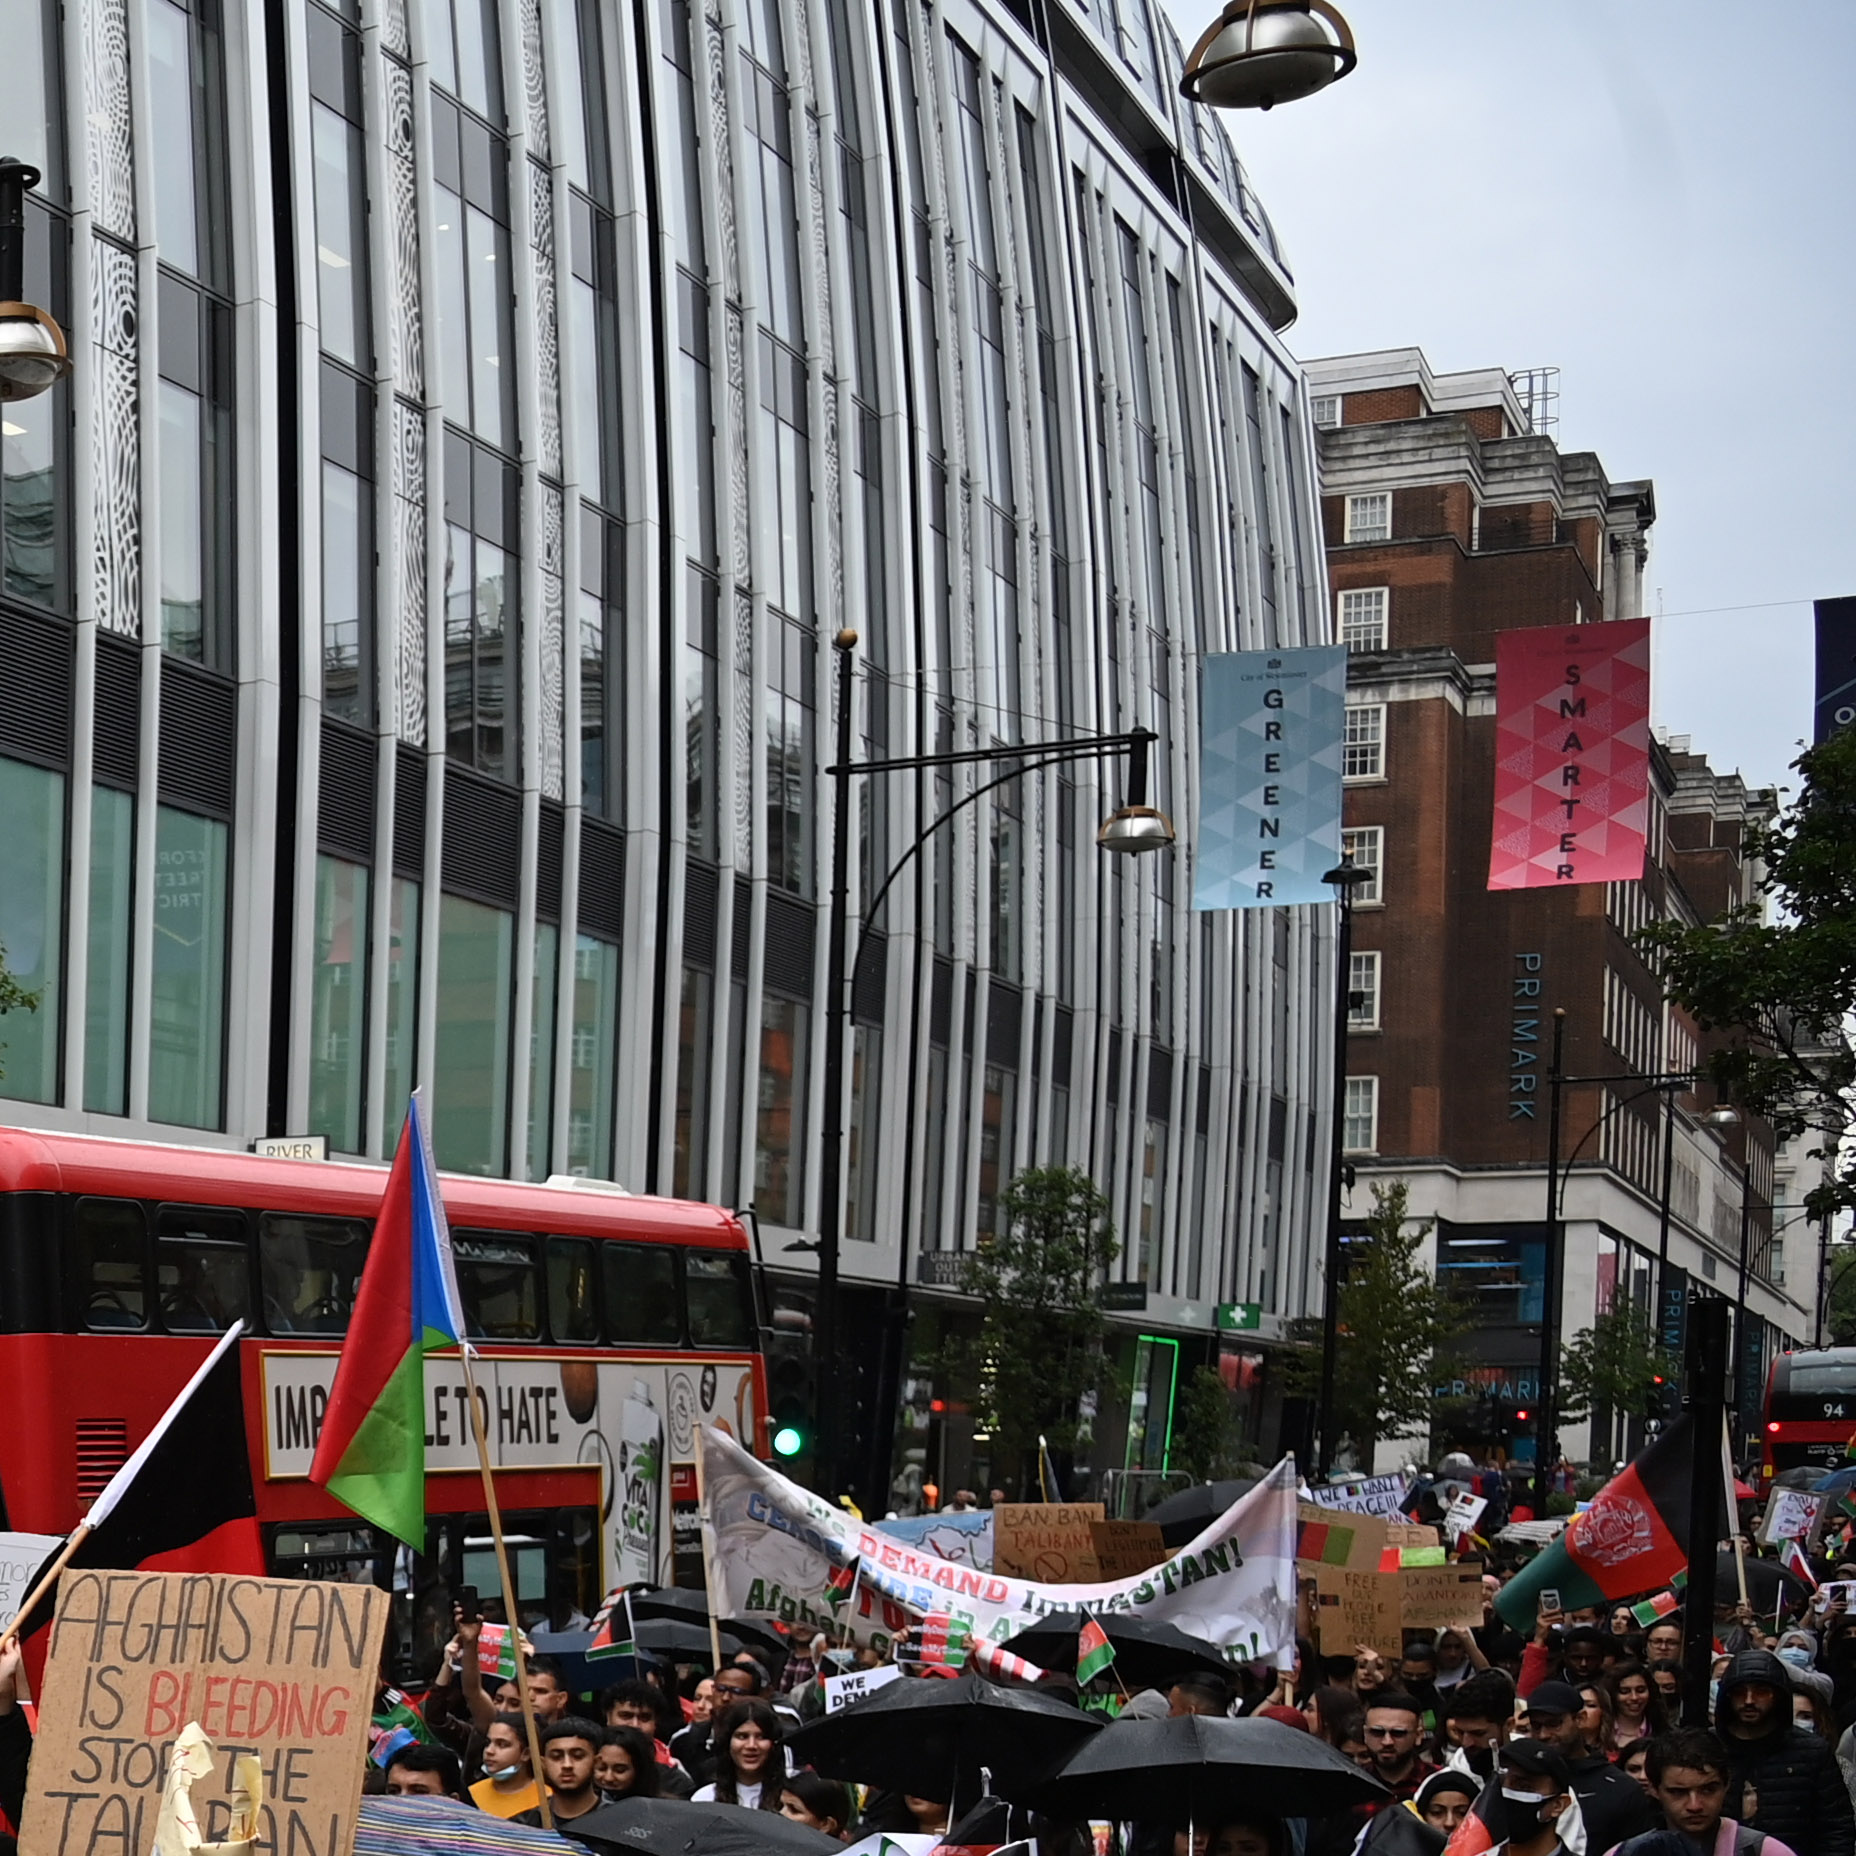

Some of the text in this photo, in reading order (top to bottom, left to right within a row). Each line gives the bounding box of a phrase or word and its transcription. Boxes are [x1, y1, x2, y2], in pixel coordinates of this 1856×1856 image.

[1255, 689, 1283, 898] GREENER
[1556, 664, 1586, 879] SMARTER
[1509, 953, 1541, 1119] PRIMARK
[267, 1143, 312, 1159] RIVER
[498, 1386, 559, 1444] HATE
[1823, 1403, 1844, 1418] 94
[1319, 1477, 1395, 1503] WE WANT
[857, 1531, 1008, 1602] DEMAND
[1344, 1573, 1379, 1590] FREE
[50, 1573, 371, 1669] AFGHAISTAN
[78, 1665, 350, 1740] IS BLEEDING
[841, 1676, 866, 1692] WE
